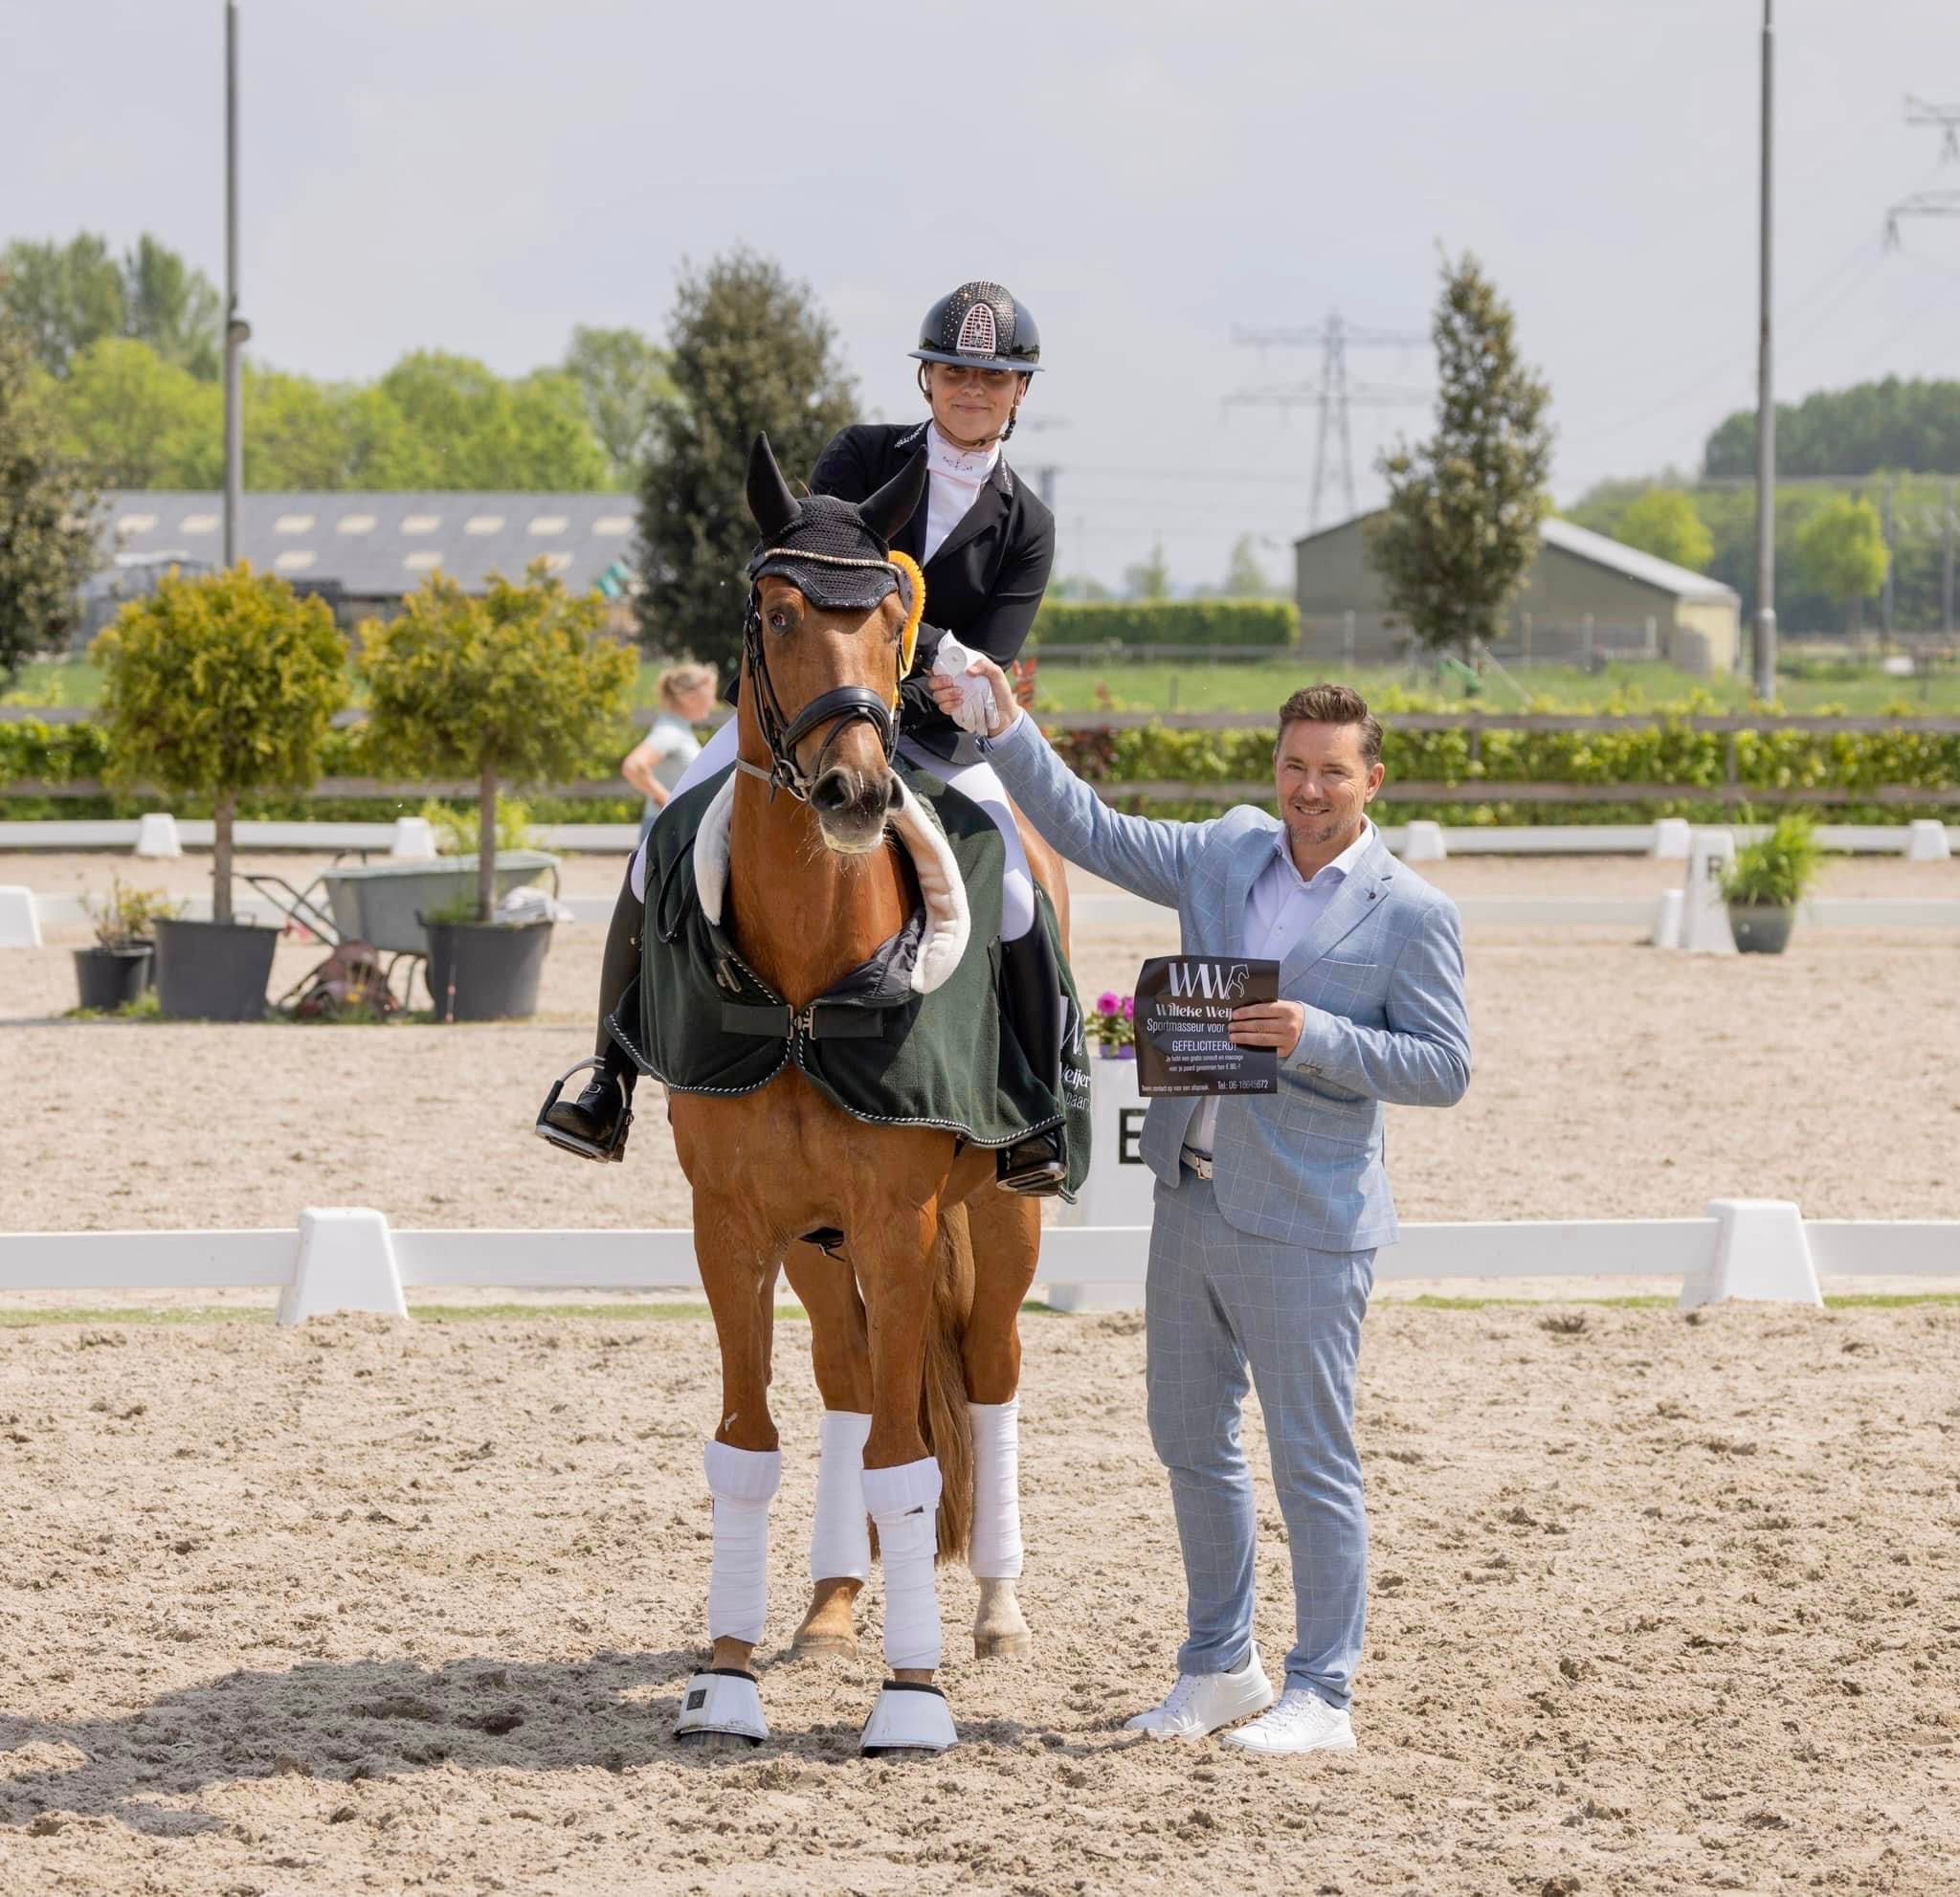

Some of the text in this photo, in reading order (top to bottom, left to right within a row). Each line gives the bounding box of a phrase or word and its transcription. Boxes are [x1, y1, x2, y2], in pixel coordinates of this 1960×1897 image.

[1155, 1003, 1233, 1020] Willeke Weij
[1147, 1017, 1224, 1034] Sportmasseur voor
[1119, 1108, 1147, 1165] E
